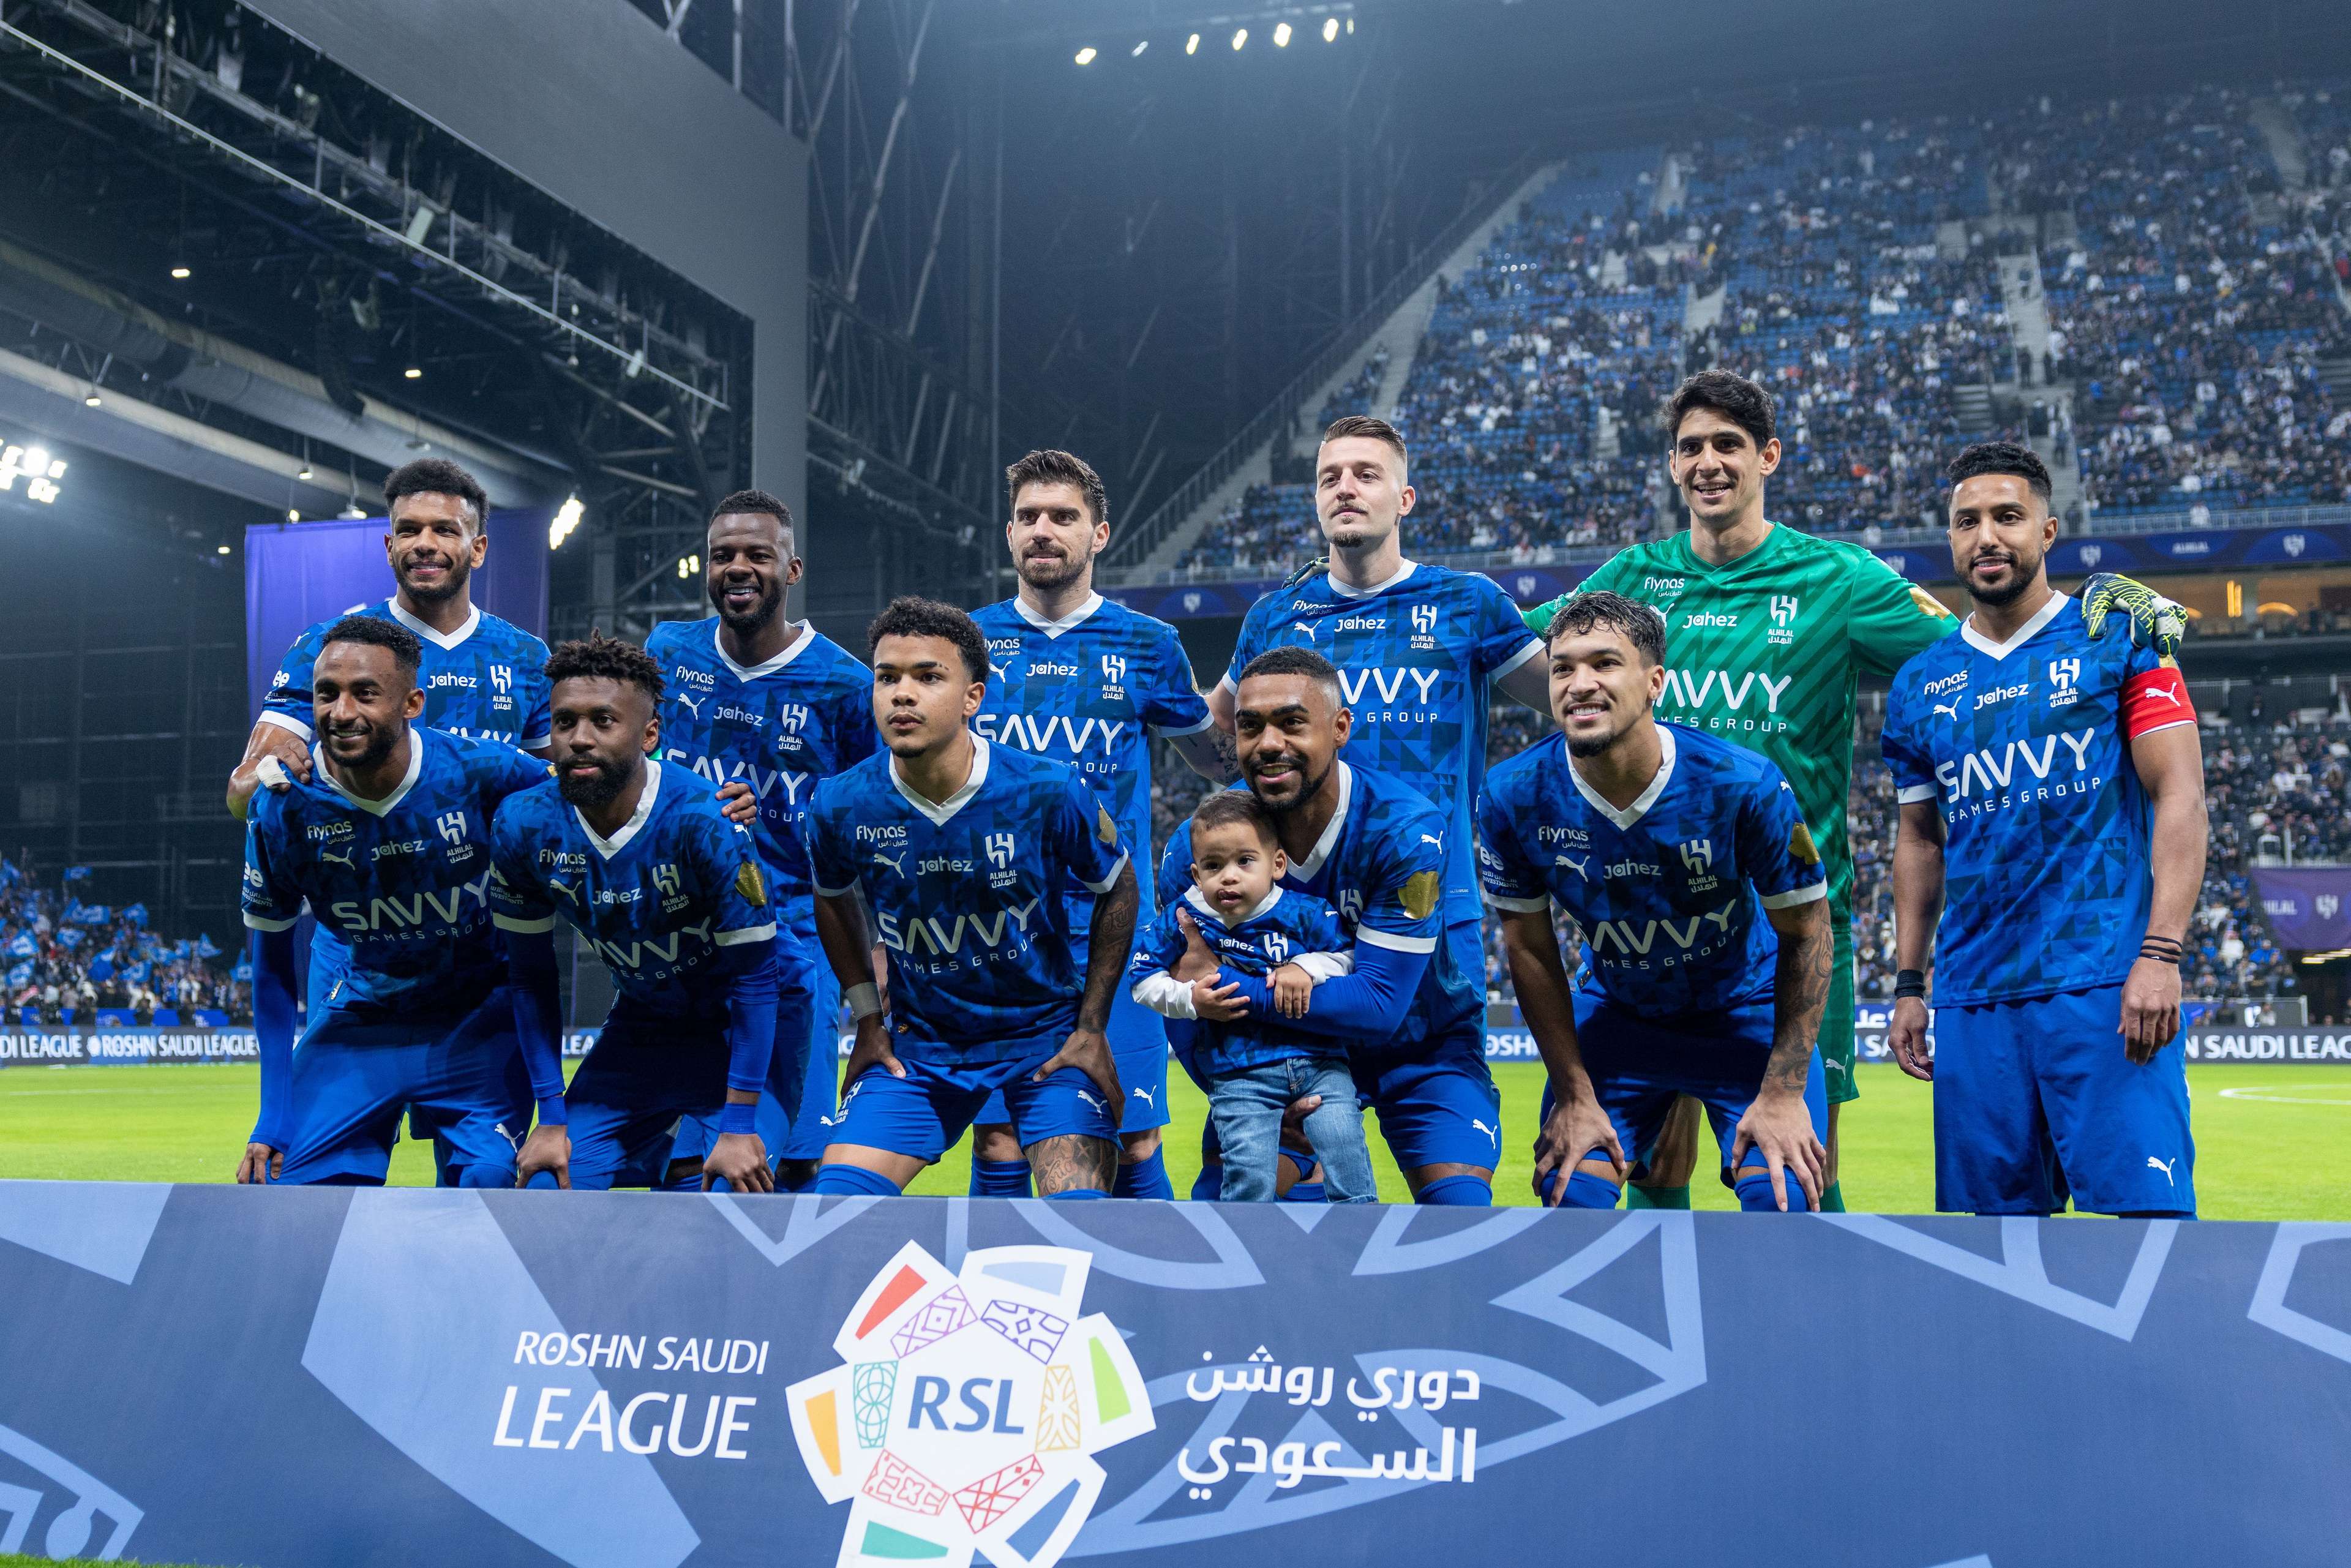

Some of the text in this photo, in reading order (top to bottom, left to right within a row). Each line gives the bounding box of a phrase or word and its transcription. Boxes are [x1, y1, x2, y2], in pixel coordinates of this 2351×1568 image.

[1644, 577, 1685, 592] flynas
[984, 638, 1020, 652] lynas
[1768, 629, 1794, 637] ALHILAL
[676, 666, 714, 685] flynas
[1337, 667, 1439, 705] VVY
[1924, 670, 1968, 695] flynas
[1102, 685, 1125, 694] ALHILAL
[1655, 669, 1792, 713] AVVY
[2049, 688, 2079, 700] ALHILAL
[1367, 711, 1438, 723] GROUP
[1710, 718, 1787, 733] GROUP
[779, 735, 803, 745] ALHILAL
[1935, 727, 2094, 804] SAVVY
[1949, 777, 2101, 823] GAMES GROUP
[307, 820, 353, 840] flynas
[857, 825, 907, 842] flynas
[1539, 826, 1589, 843] flynas
[447, 844, 473, 857] ALHILAL
[539, 849, 587, 866] flynas
[989, 869, 1018, 880] ALHILAL
[1688, 874, 1717, 886] ALHILAL
[331, 869, 490, 931] SAVVY
[662, 893, 689, 907] ALHILAL
[353, 912, 491, 942] GAMES GROU
[878, 898, 1039, 955] SAVVY
[1591, 899, 1736, 954] AVVY
[593, 916, 711, 968] AVVY
[892, 932, 1038, 974] GAMES GROUP
[1602, 926, 1738, 970] MES GROUP
[655, 947, 713, 980] GROU
[21, 1035, 83, 1058] LEAGUE
[102, 1034, 157, 1057] ROSHN
[158, 1034, 204, 1057] SAUDI
[204, 1034, 257, 1056] LEAGUE
[561, 1035, 594, 1055] LEA
[1485, 1034, 1538, 1056] OSH
[2204, 1035, 2285, 1059] SAUDI
[514, 1331, 770, 1375] ROSHN SAUDI
[1187, 1345, 1480, 1423] دوري روشن
[908, 1375, 1026, 1435] RSL
[493, 1385, 757, 1460] LEAGUE
[1177, 1427, 1477, 1500] السعودي
